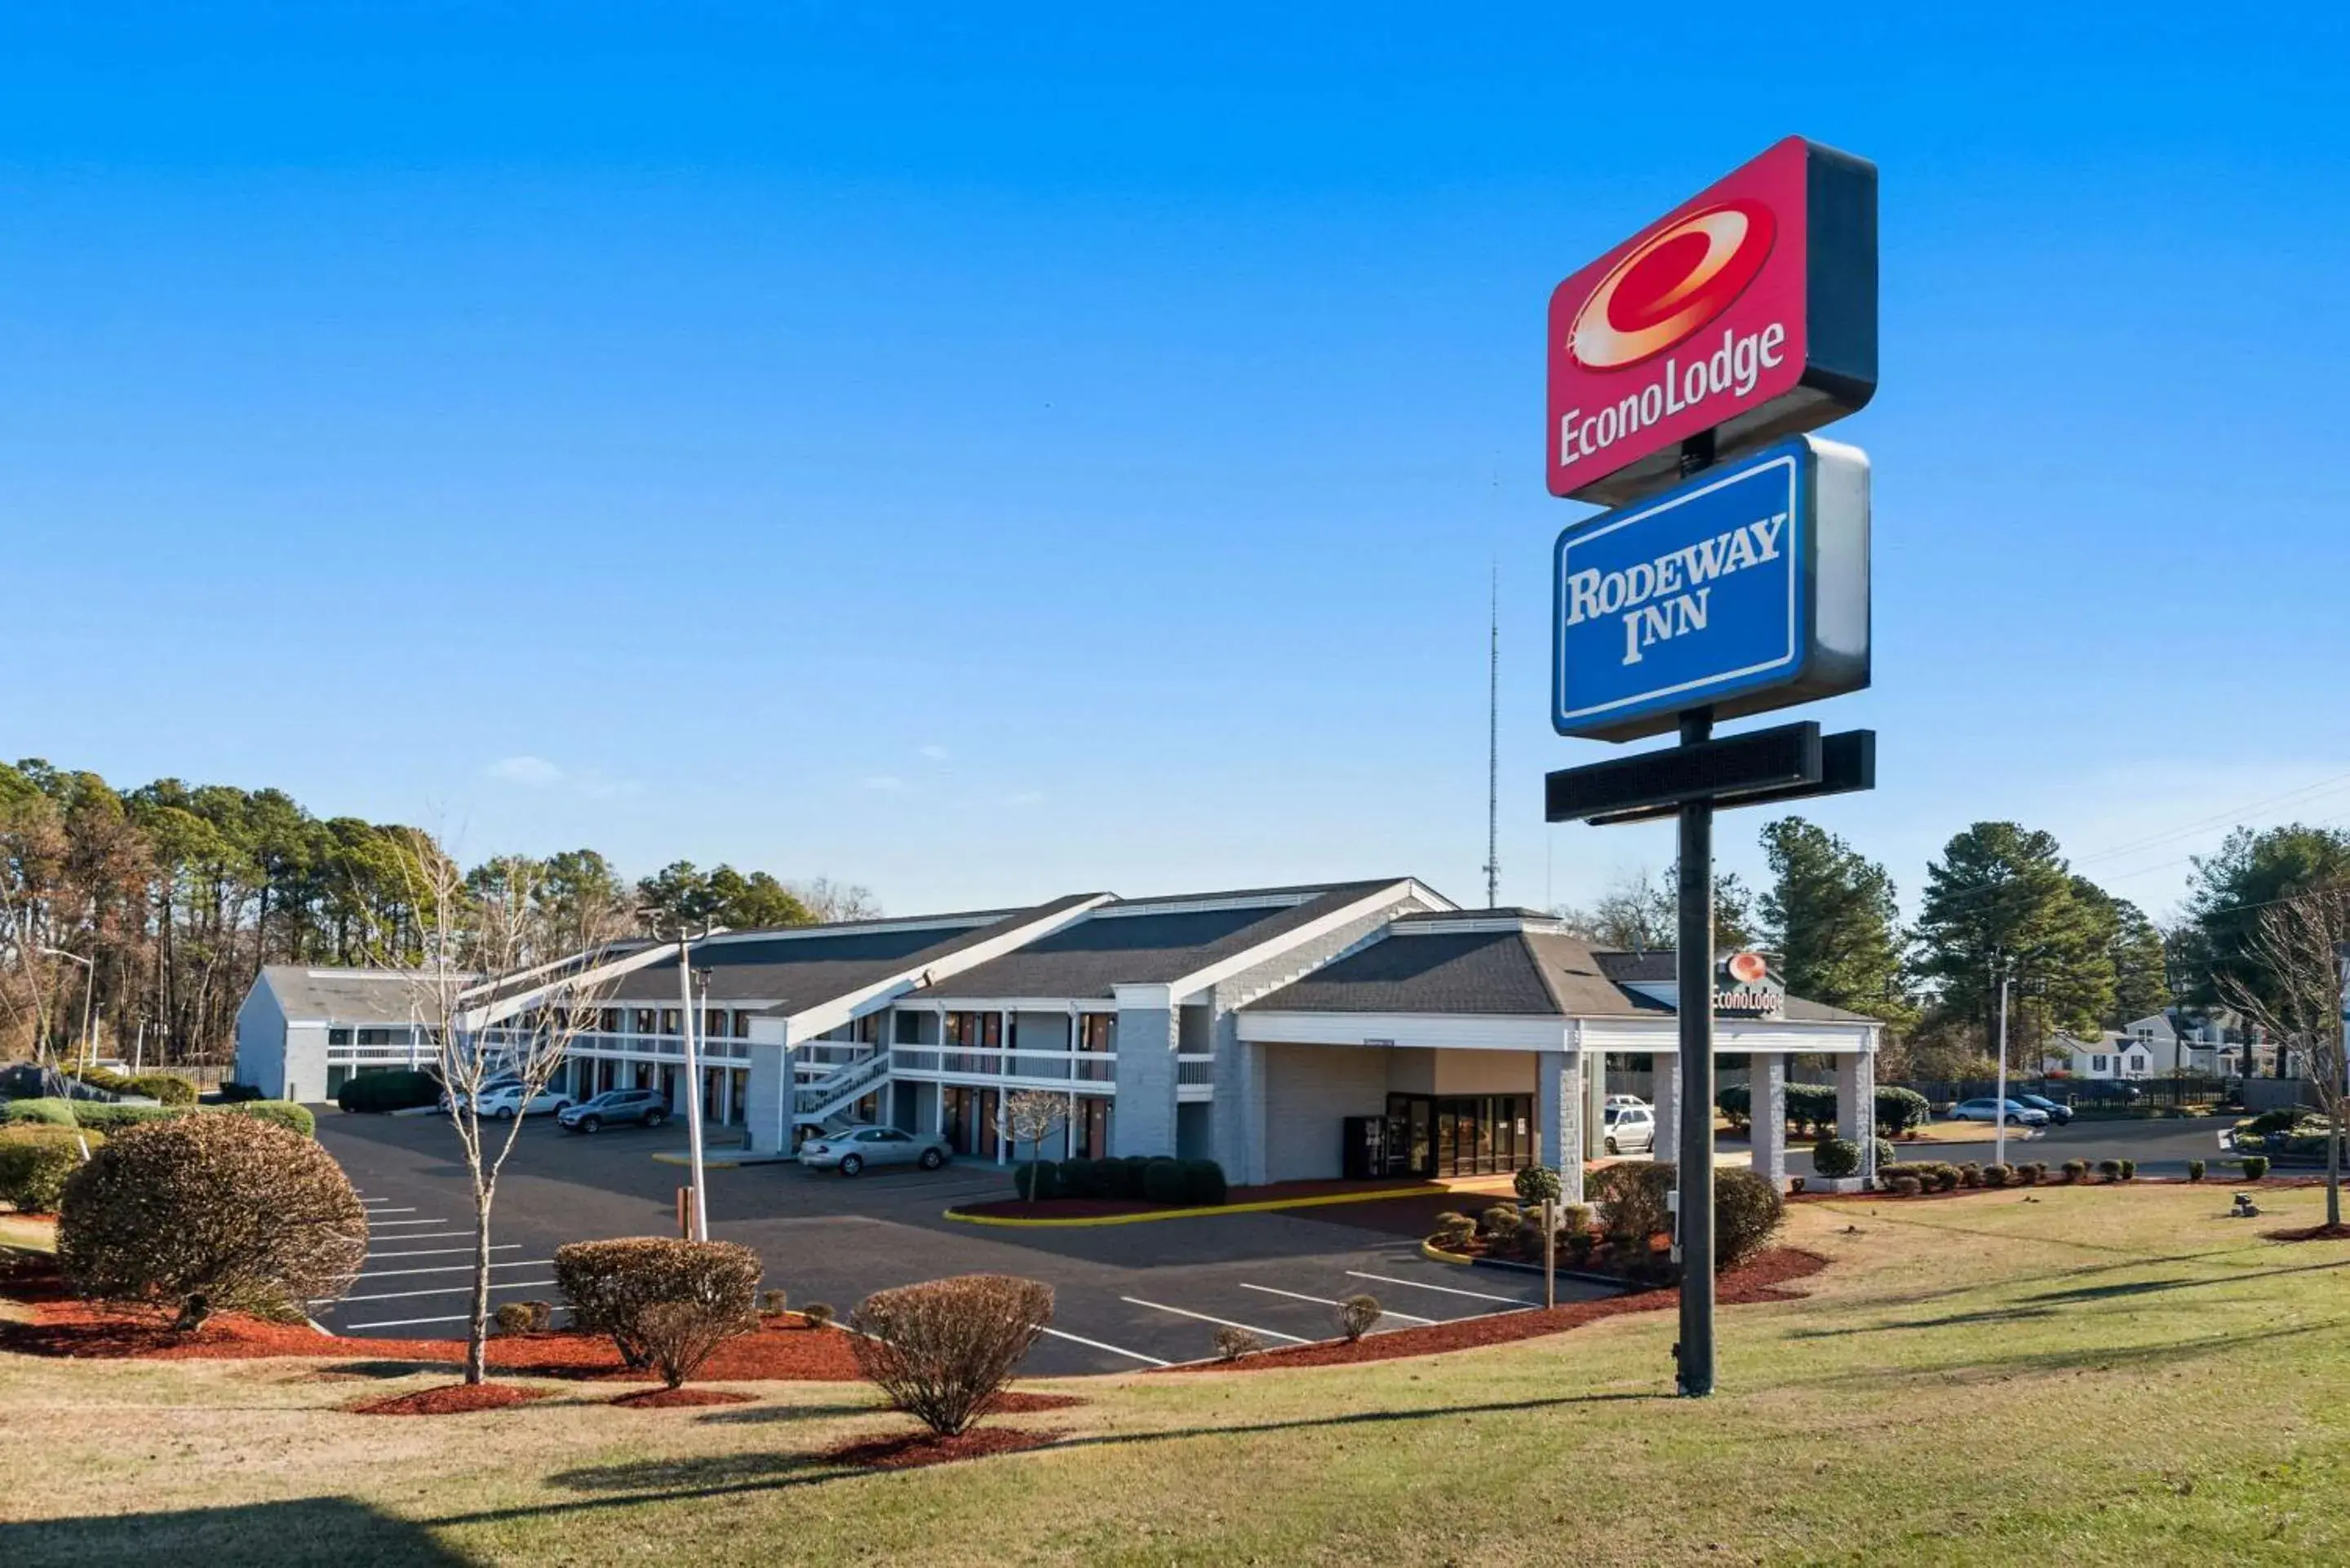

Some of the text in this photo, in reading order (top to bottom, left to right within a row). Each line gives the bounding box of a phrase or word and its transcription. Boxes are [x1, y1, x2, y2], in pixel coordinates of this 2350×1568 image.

[1560, 322, 1785, 466] EconoLodge
[1567, 512, 1786, 626] RODEWAY
[1622, 587, 1710, 666] INN
